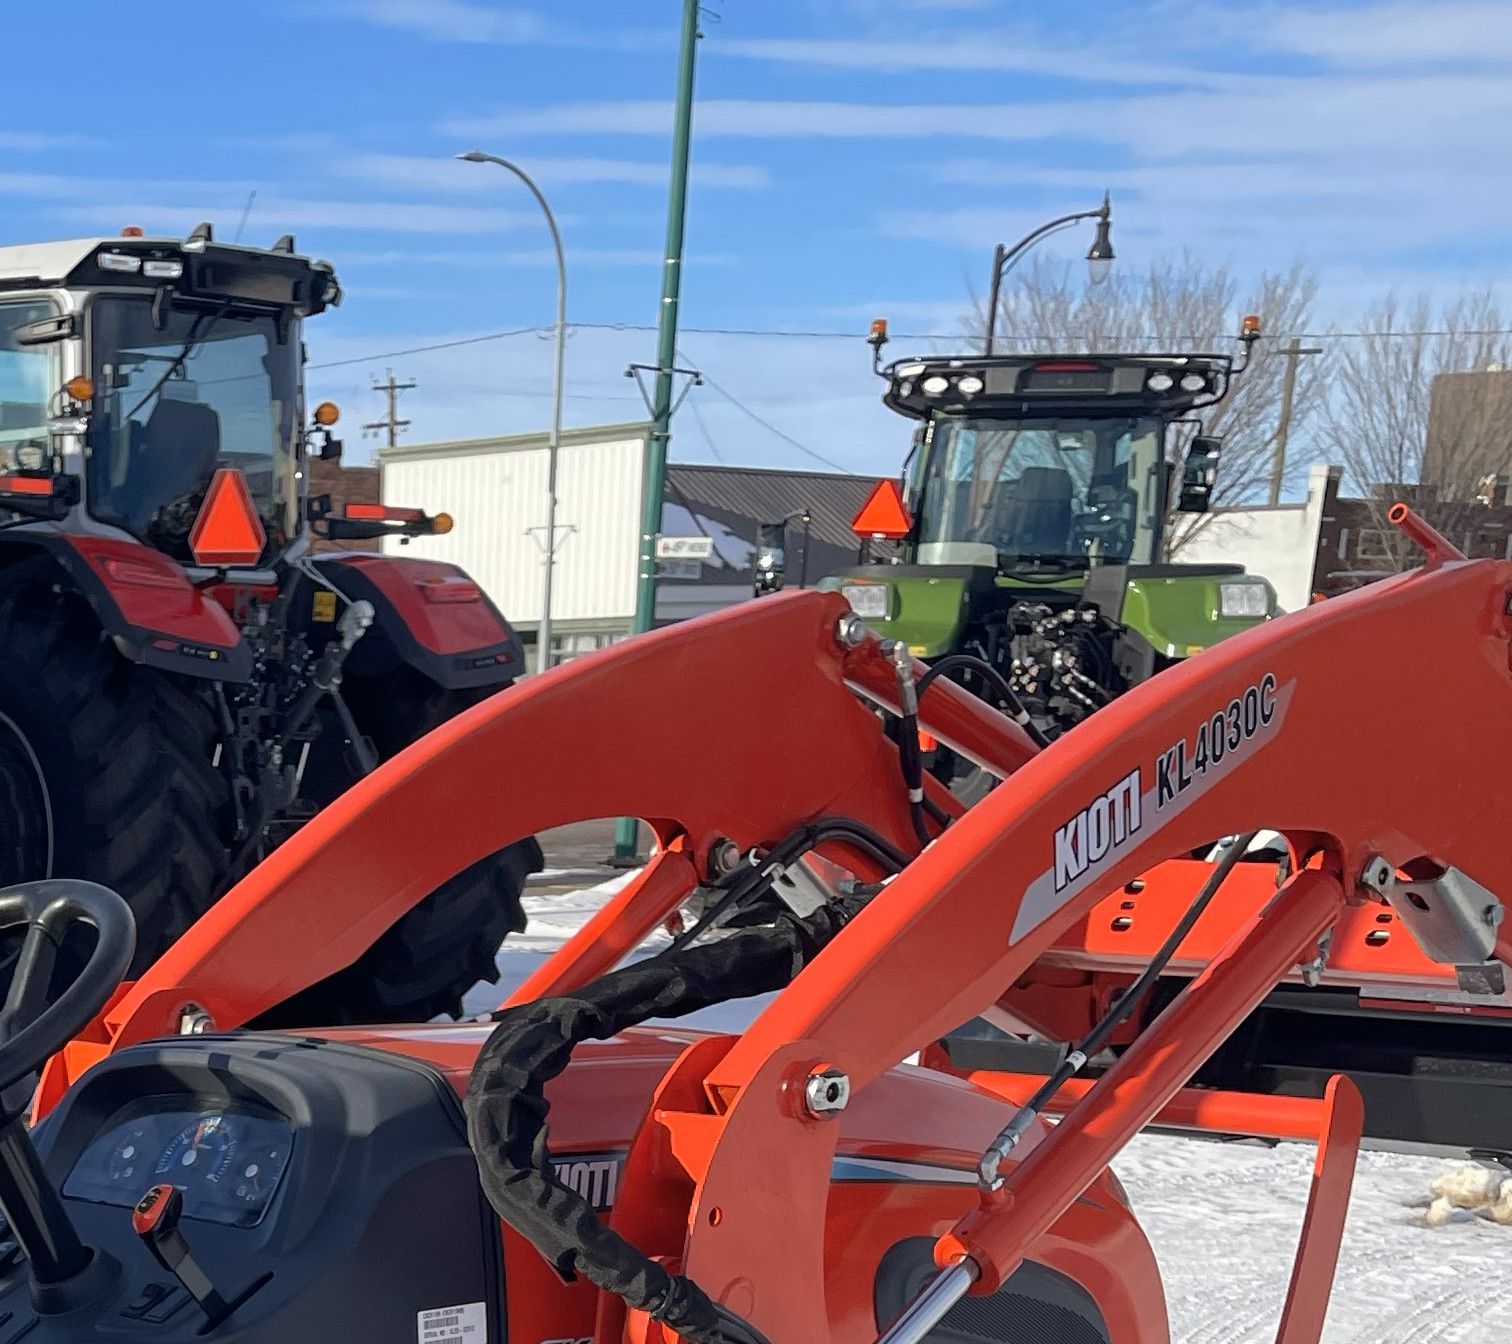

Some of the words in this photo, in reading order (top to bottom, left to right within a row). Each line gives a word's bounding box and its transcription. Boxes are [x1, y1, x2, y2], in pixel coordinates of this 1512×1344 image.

[1053, 766, 1142, 894] KIOTI
[1155, 672, 1278, 813] KL4030C
[554, 1160, 619, 1207] IOTI
